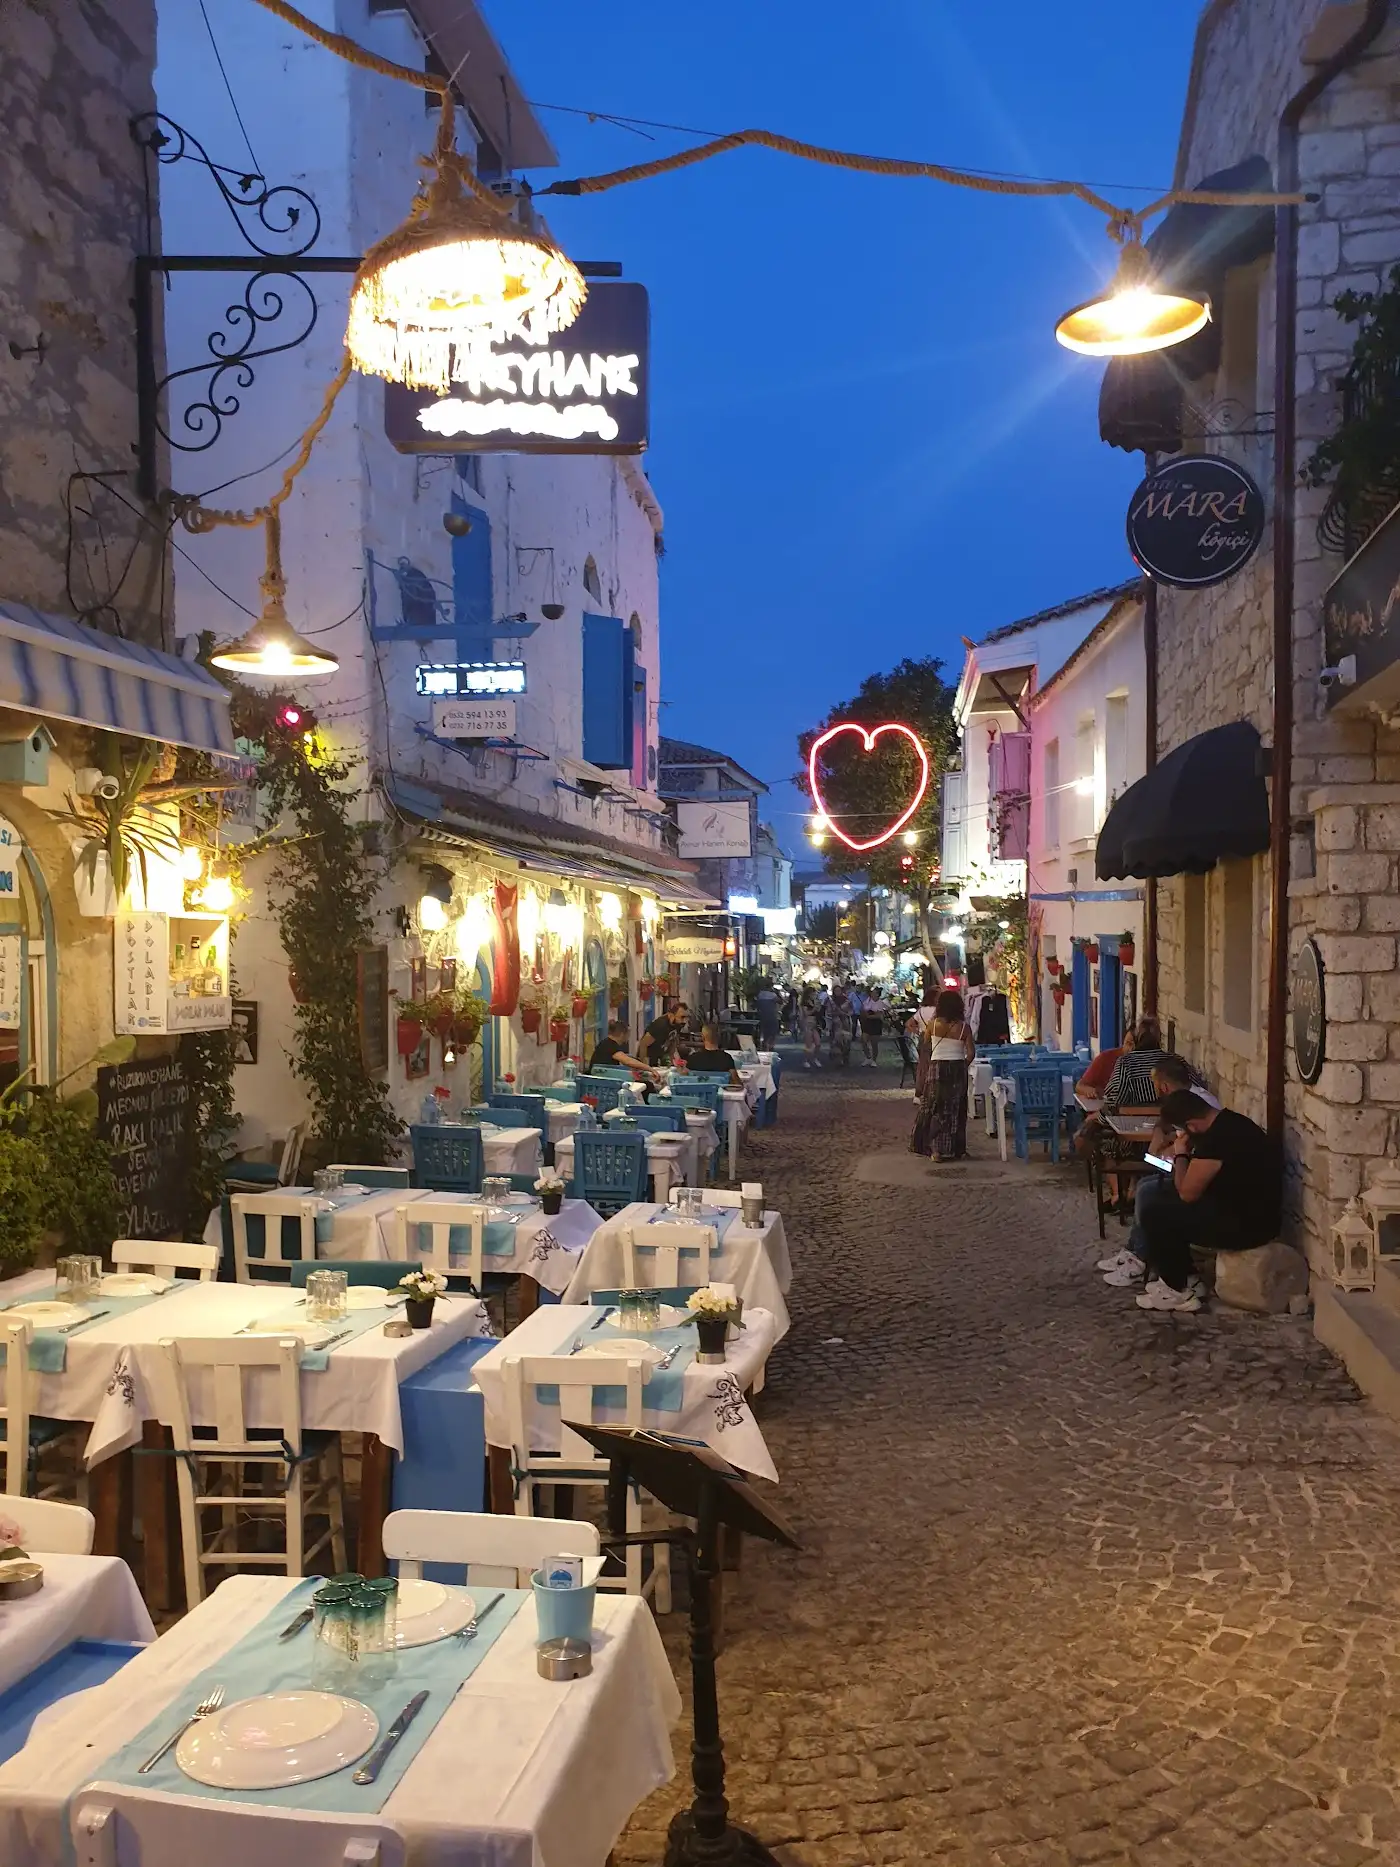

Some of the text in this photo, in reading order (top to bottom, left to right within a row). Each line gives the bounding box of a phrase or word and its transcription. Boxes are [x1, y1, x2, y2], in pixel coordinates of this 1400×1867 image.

[466, 711, 481, 719] 594
[485, 710, 494, 718] 13
[496, 710, 507, 718] 93
[467, 722, 482, 730] 716
[497, 722, 507, 730] 35
[126, 920, 137, 1026] DOSTLAR
[144, 920, 155, 1011] DOLABI
